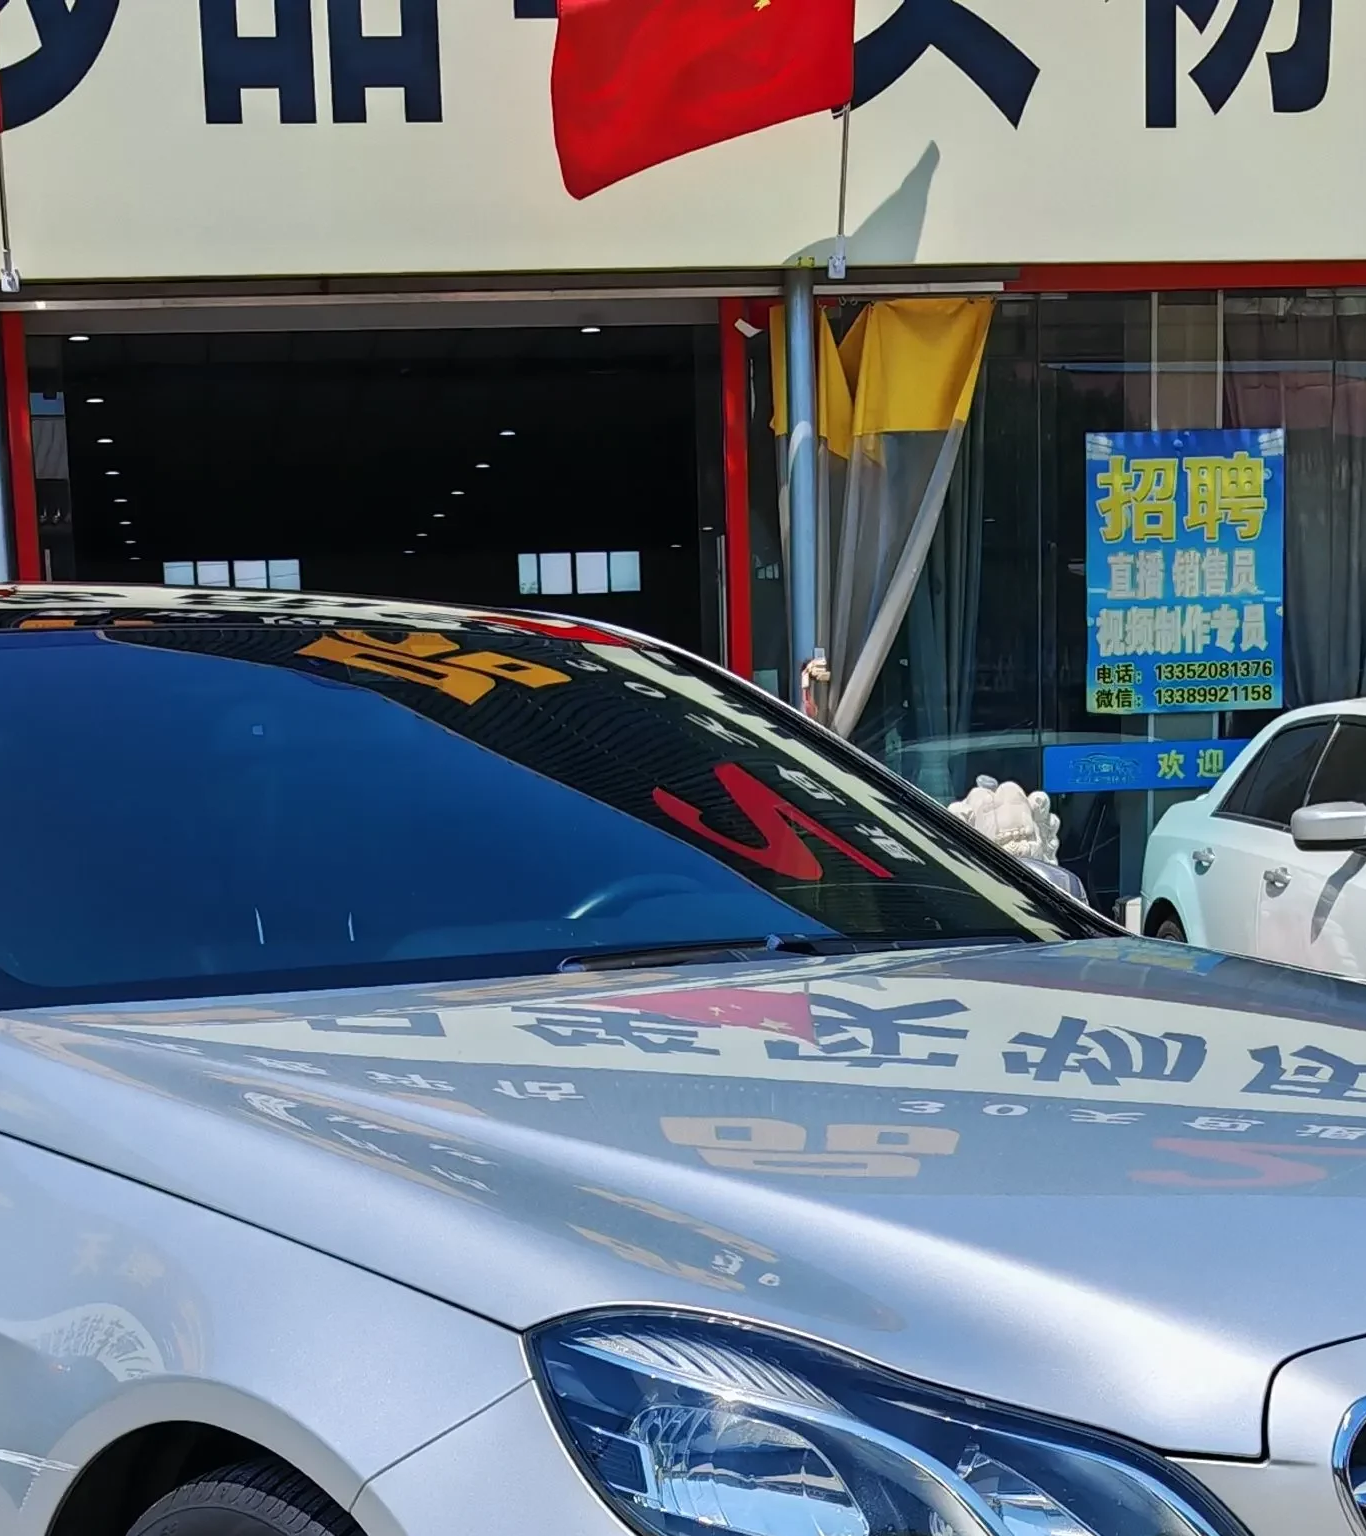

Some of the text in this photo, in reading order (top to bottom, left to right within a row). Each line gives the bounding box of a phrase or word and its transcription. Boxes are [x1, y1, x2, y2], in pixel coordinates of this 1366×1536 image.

[1096, 451, 1268, 543] 招聘
[1107, 550, 1165, 600] 直播
[1096, 603, 1269, 657] 视频制作专员
[1154, 660, 1273, 682] 13352081376
[1154, 685, 1273, 707] 13389921158
